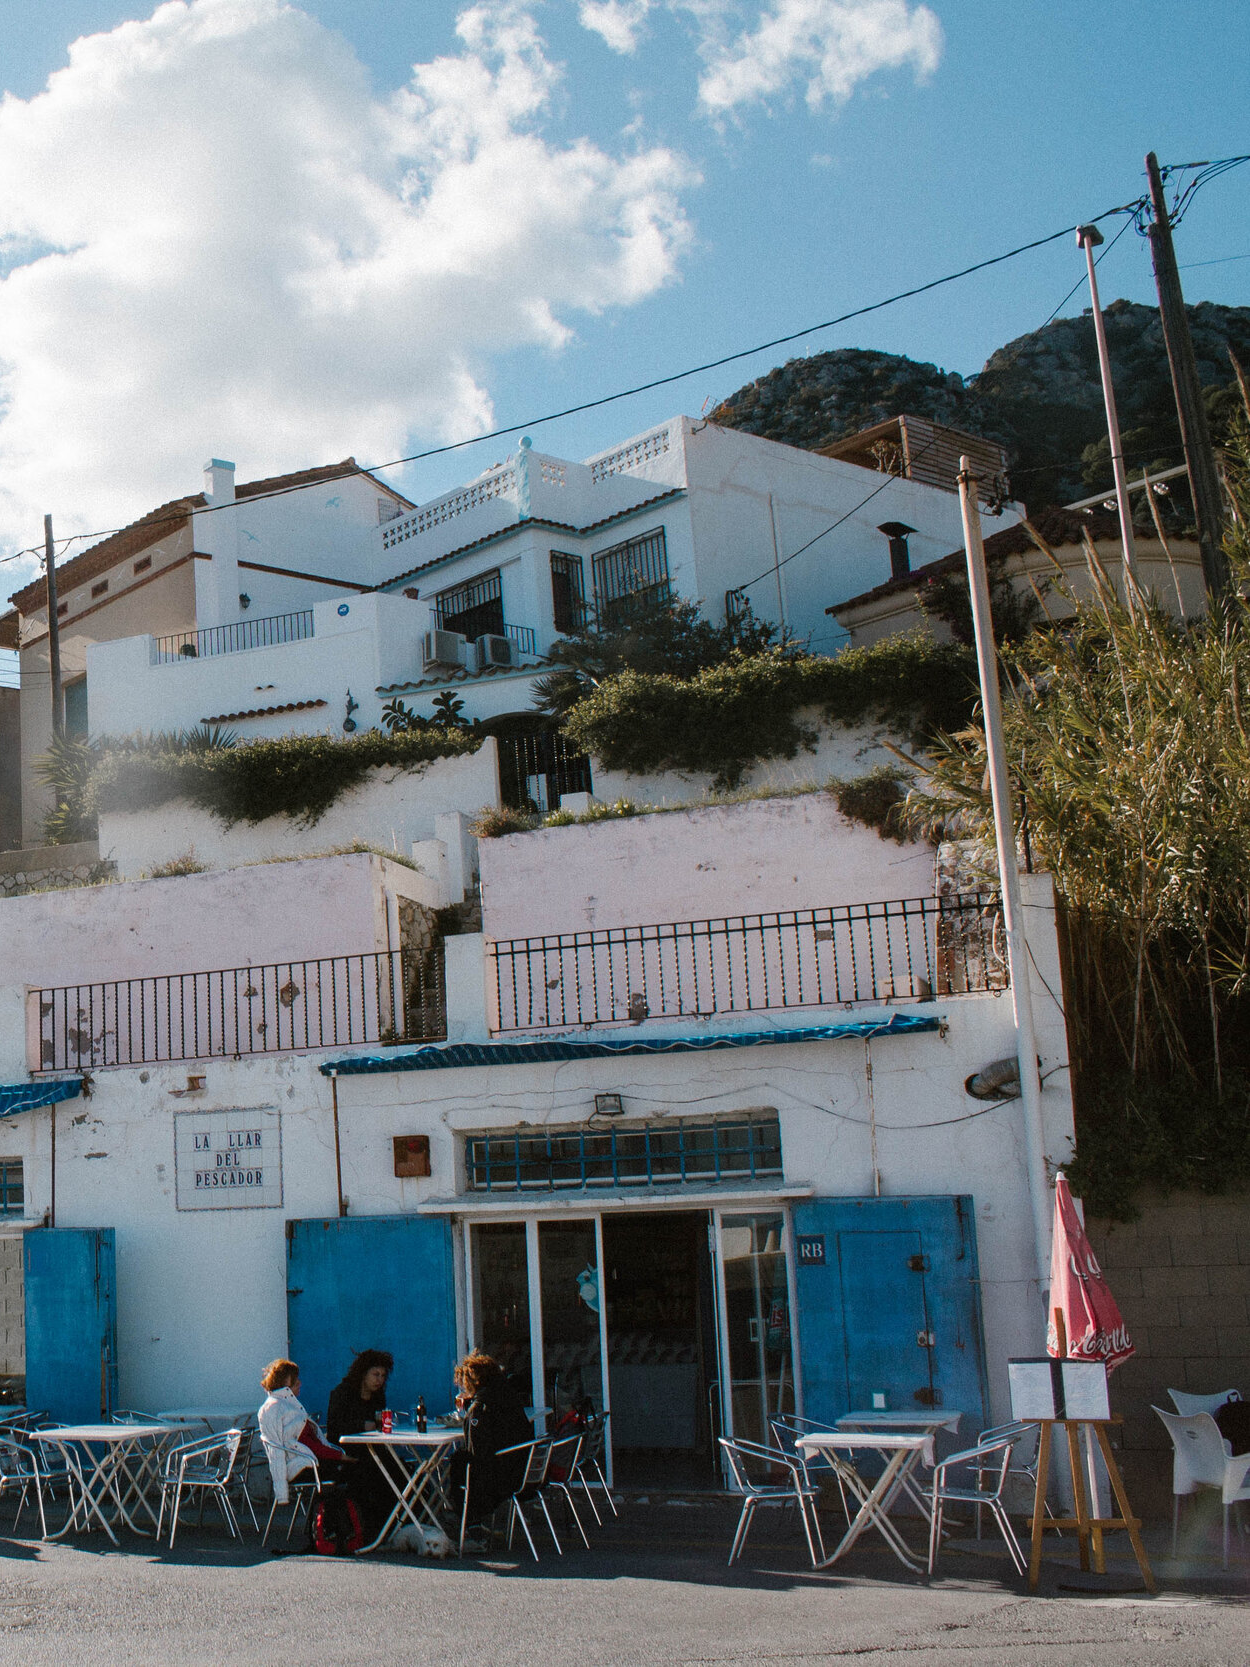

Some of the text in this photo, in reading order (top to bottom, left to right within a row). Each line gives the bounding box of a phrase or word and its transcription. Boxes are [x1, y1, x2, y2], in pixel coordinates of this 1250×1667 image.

[195, 1133, 262, 1149] LA LLAR
[216, 1153, 240, 1167] DEL
[196, 1171, 262, 1186] PESCADOR
[801, 1242, 823, 1258] RB
